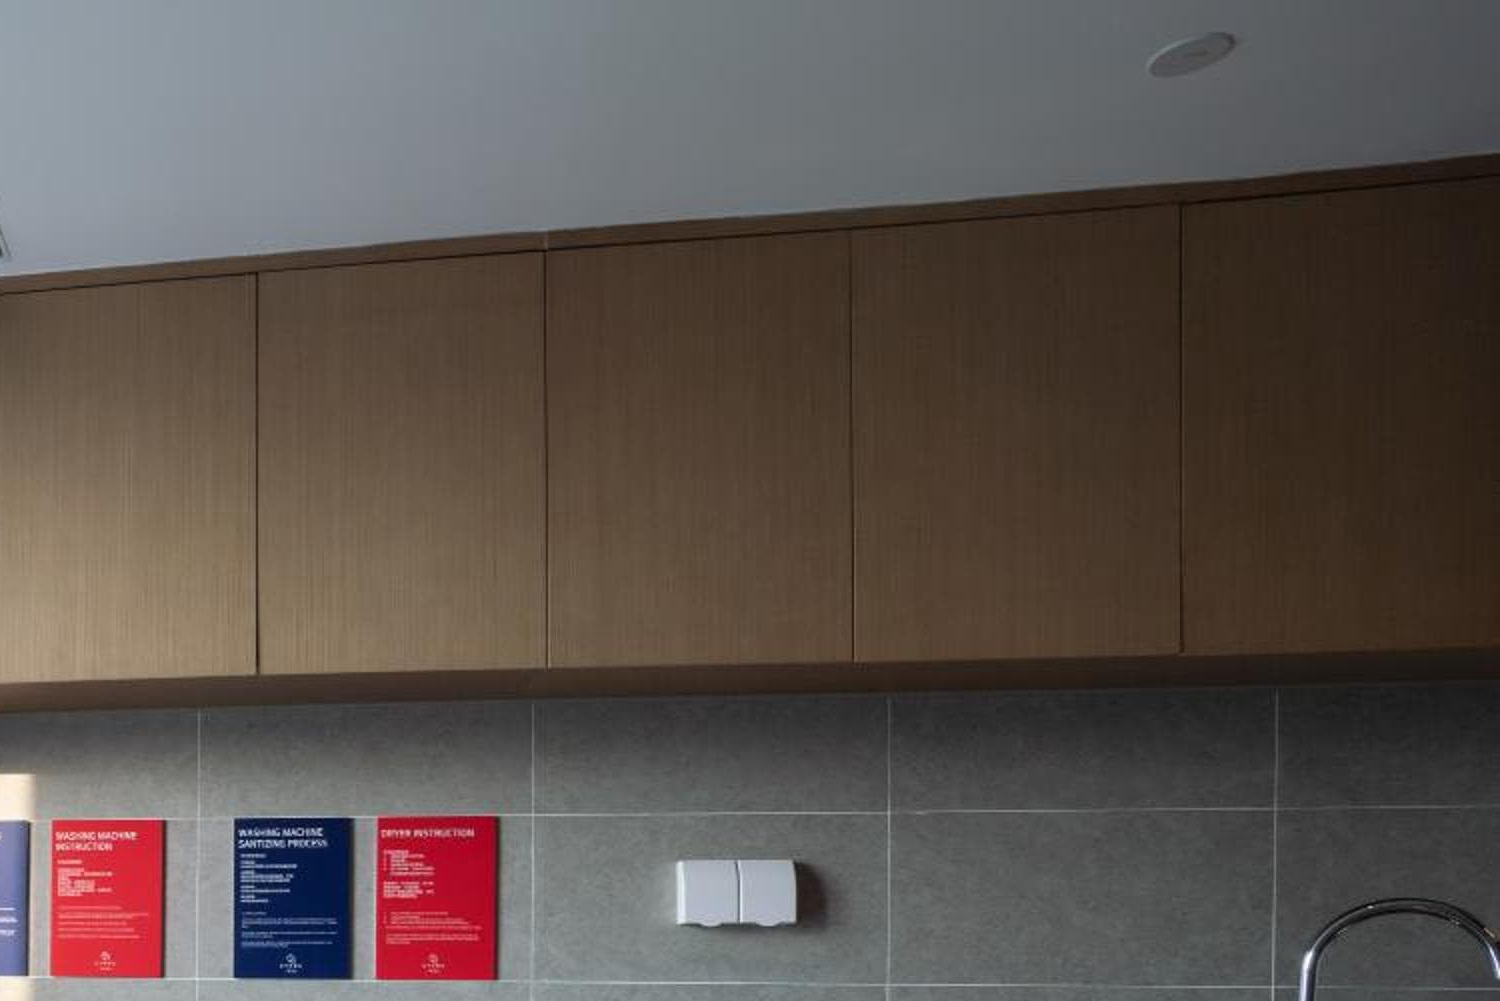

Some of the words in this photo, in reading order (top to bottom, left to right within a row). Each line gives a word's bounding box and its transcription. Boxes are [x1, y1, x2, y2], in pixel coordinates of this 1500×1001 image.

[55, 831, 97, 840] WASHING
[98, 831, 137, 840] MACHINE
[238, 828, 281, 837] WASHING
[282, 827, 324, 837] MACHINE
[381, 829, 411, 838] DRYER
[413, 828, 475, 838] INSTRUCTION
[55, 842, 113, 851] INSTRUCTION
[287, 839, 328, 849] PROCESS
